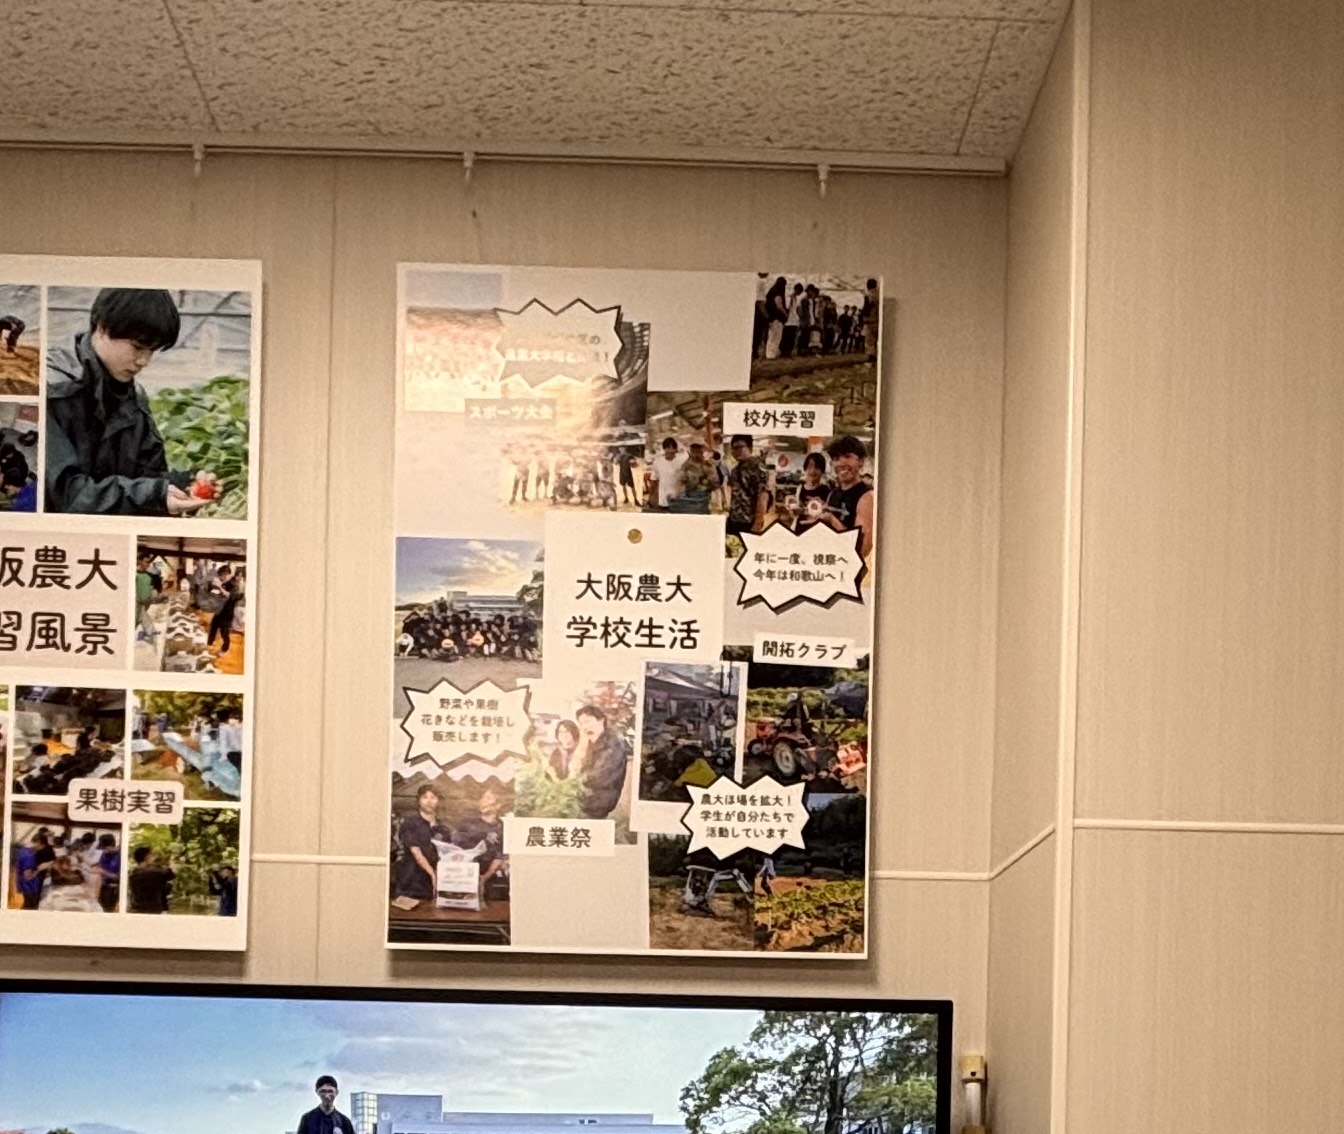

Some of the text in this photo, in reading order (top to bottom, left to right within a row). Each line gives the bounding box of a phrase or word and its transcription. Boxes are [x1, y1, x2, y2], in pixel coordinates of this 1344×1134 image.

[743, 410, 817, 429] 校外学習
[575, 572, 693, 603] 大阪農大
[565, 616, 701, 650] 学校生活
[761, 639, 847, 660] 開拓クラブ
[439, 698, 499, 711] 野菜や果樹
[76, 788, 177, 817] 果樹実習
[700, 810, 795, 823] 学生が自分たちで
[525, 827, 592, 850] 農業祭
[706, 826, 789, 839] 活動しています
